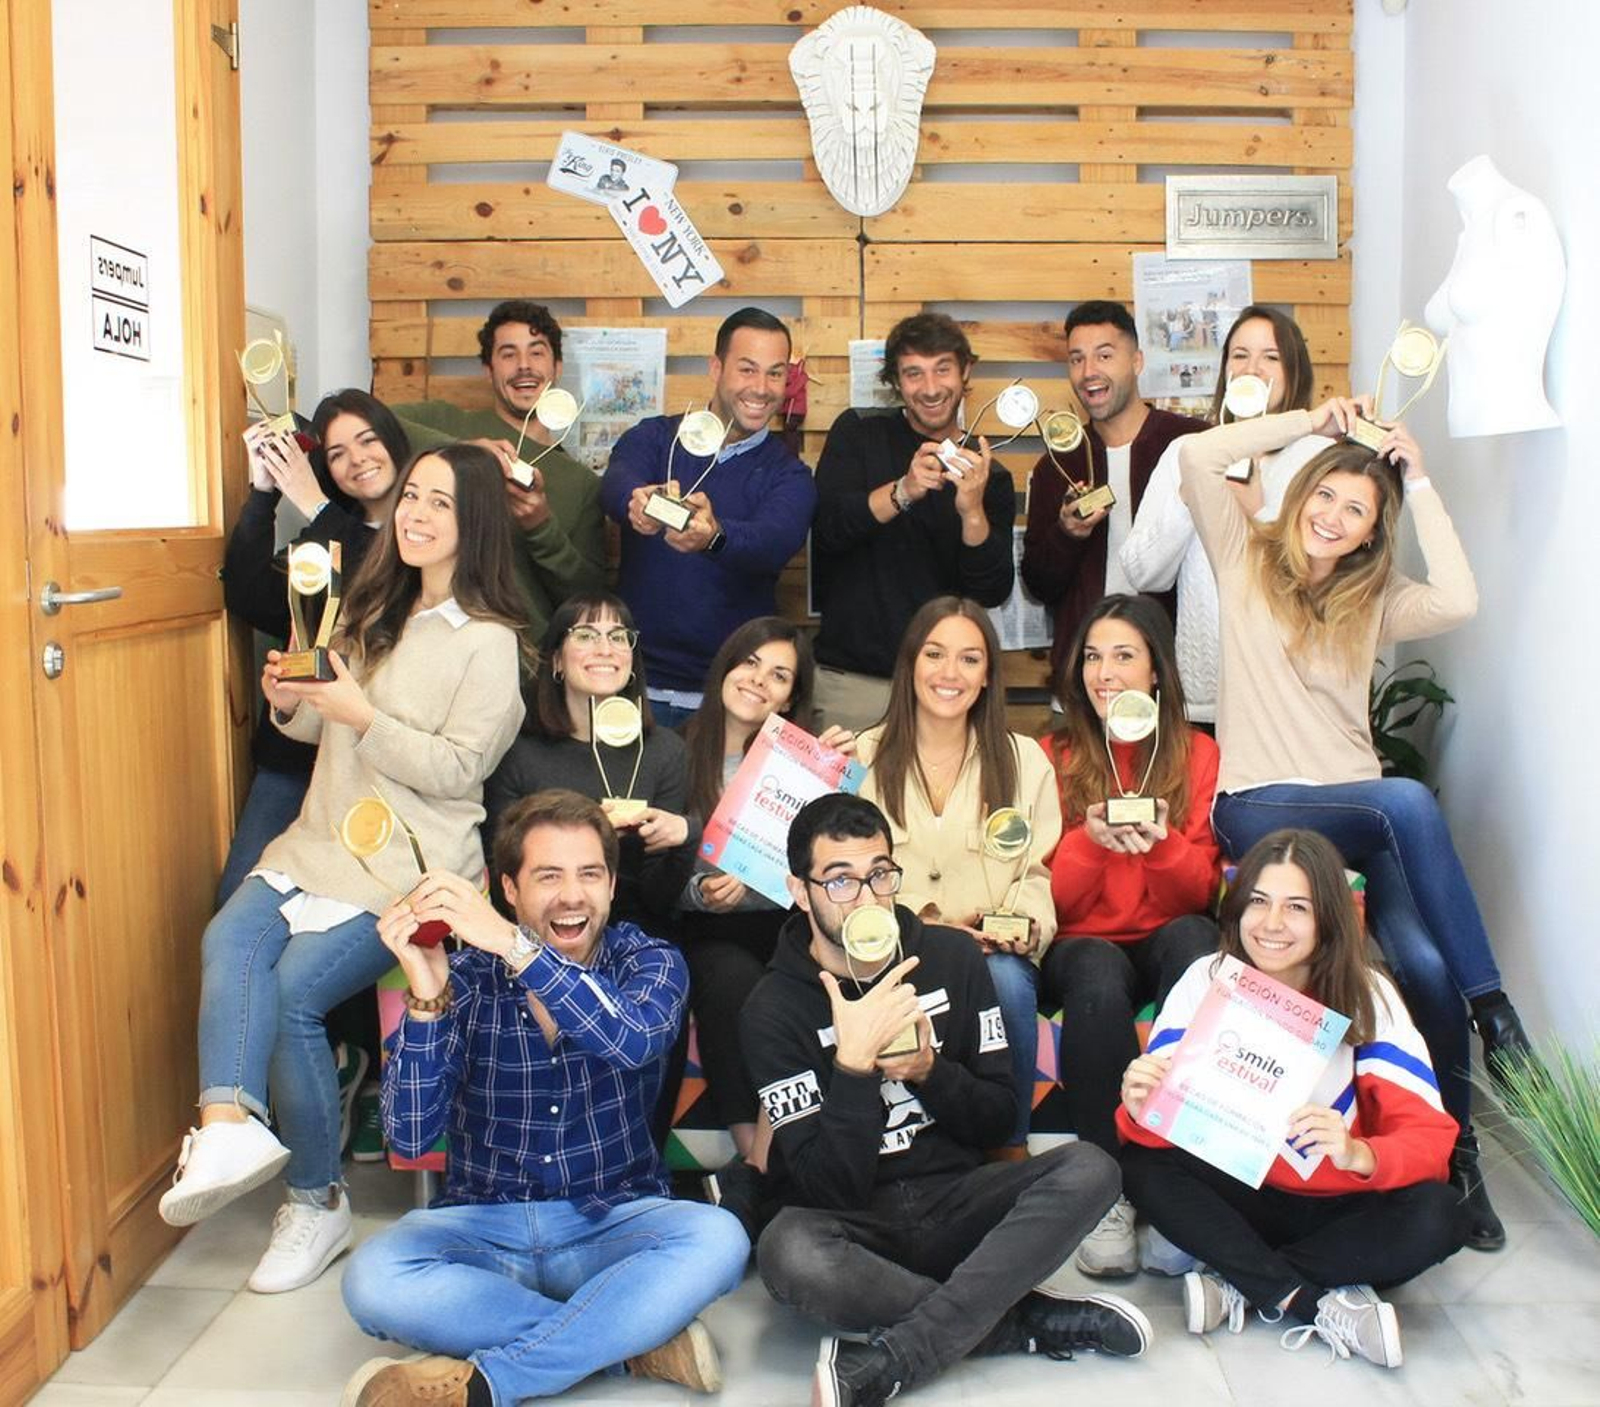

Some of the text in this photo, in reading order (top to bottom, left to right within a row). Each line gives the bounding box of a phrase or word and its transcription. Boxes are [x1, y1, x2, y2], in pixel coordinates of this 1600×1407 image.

[622, 187, 651, 213] I
[650, 231, 705, 289] NY
[666, 199, 705, 256] NEW YORK
[1282, 1000, 1331, 1034] SOCIAL
[1235, 1047, 1284, 1079] smile
